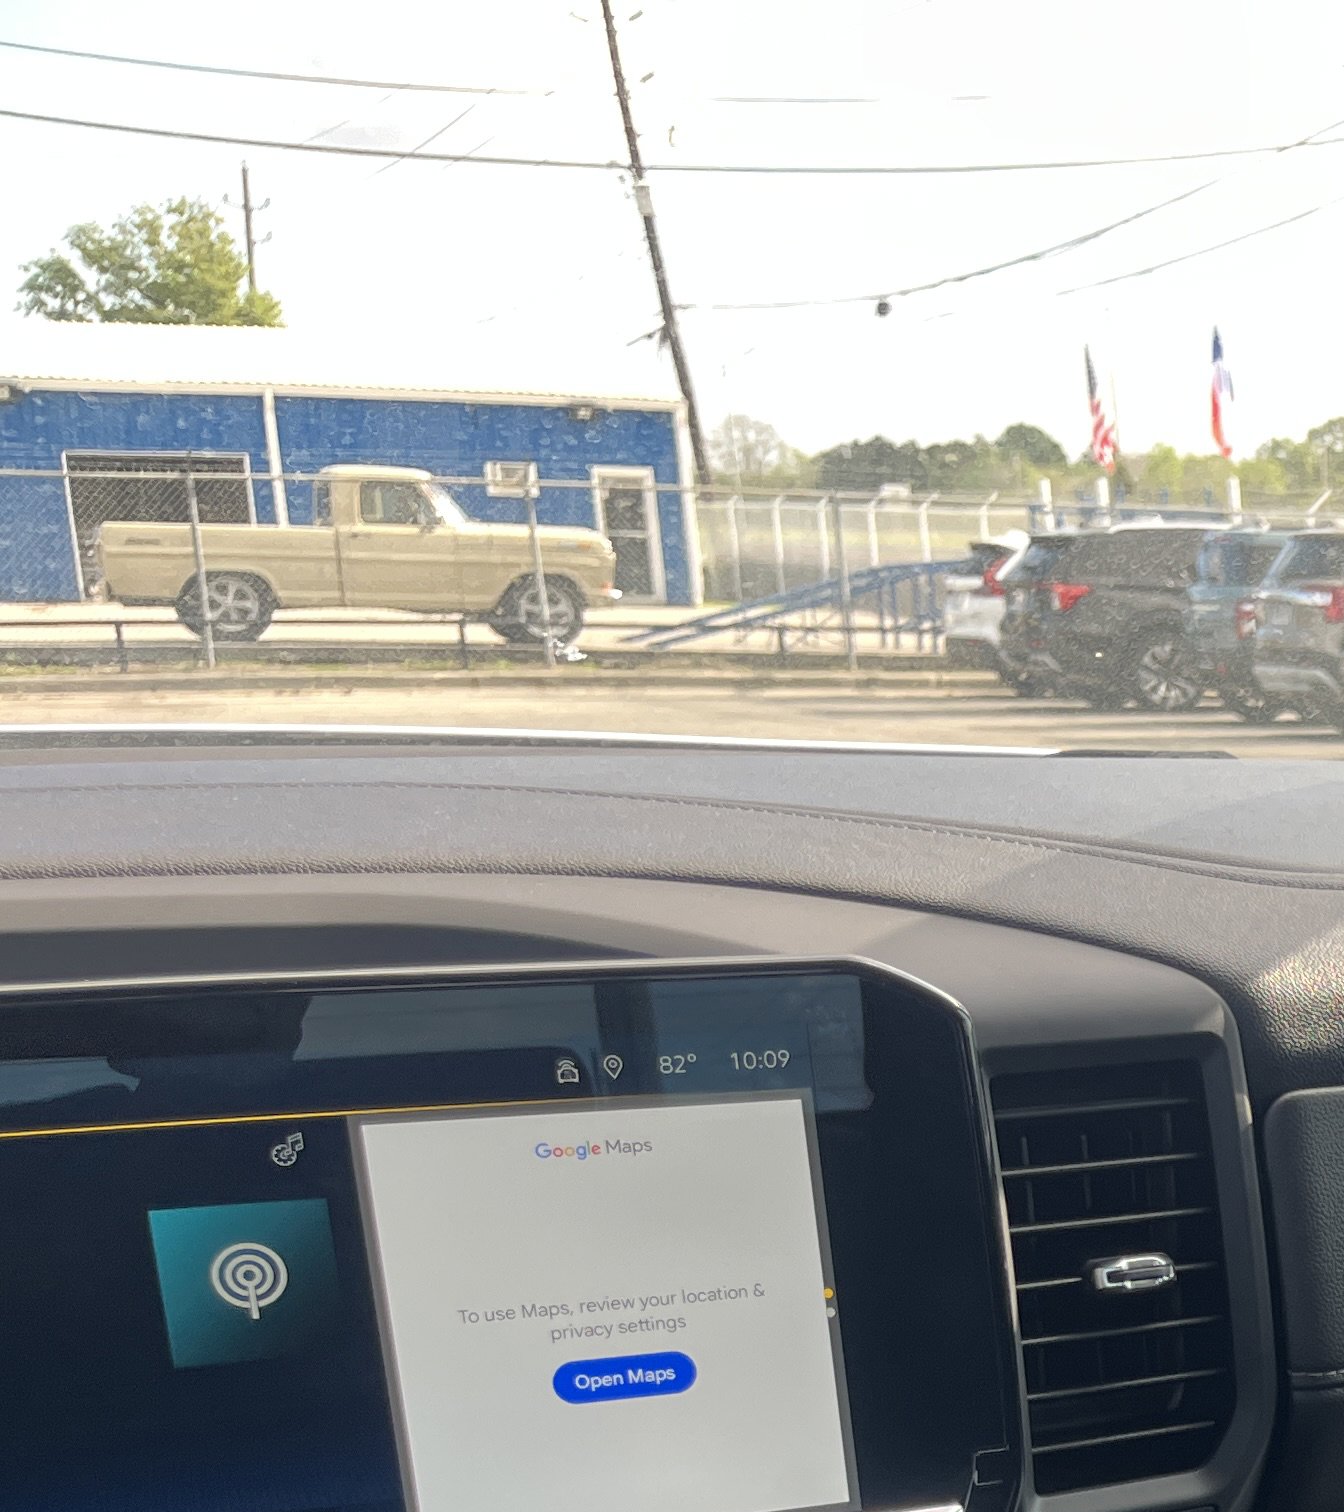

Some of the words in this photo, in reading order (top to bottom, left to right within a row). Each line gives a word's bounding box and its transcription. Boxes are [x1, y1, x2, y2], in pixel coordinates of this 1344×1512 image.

[731, 1049, 791, 1071] 10:09
[535, 1140, 602, 1160] Google
[605, 1139, 653, 1156] Maps
[458, 1308, 480, 1325] To
[484, 1308, 516, 1322] use
[521, 1302, 574, 1320] Maps,
[579, 1296, 635, 1314] review
[639, 1295, 678, 1312] your
[681, 1284, 749, 1304] location
[752, 1283, 765, 1298] &
[550, 1321, 614, 1344] privacy
[618, 1315, 687, 1336] settings
[574, 1373, 625, 1392] Open
[627, 1367, 676, 1385] Maps
